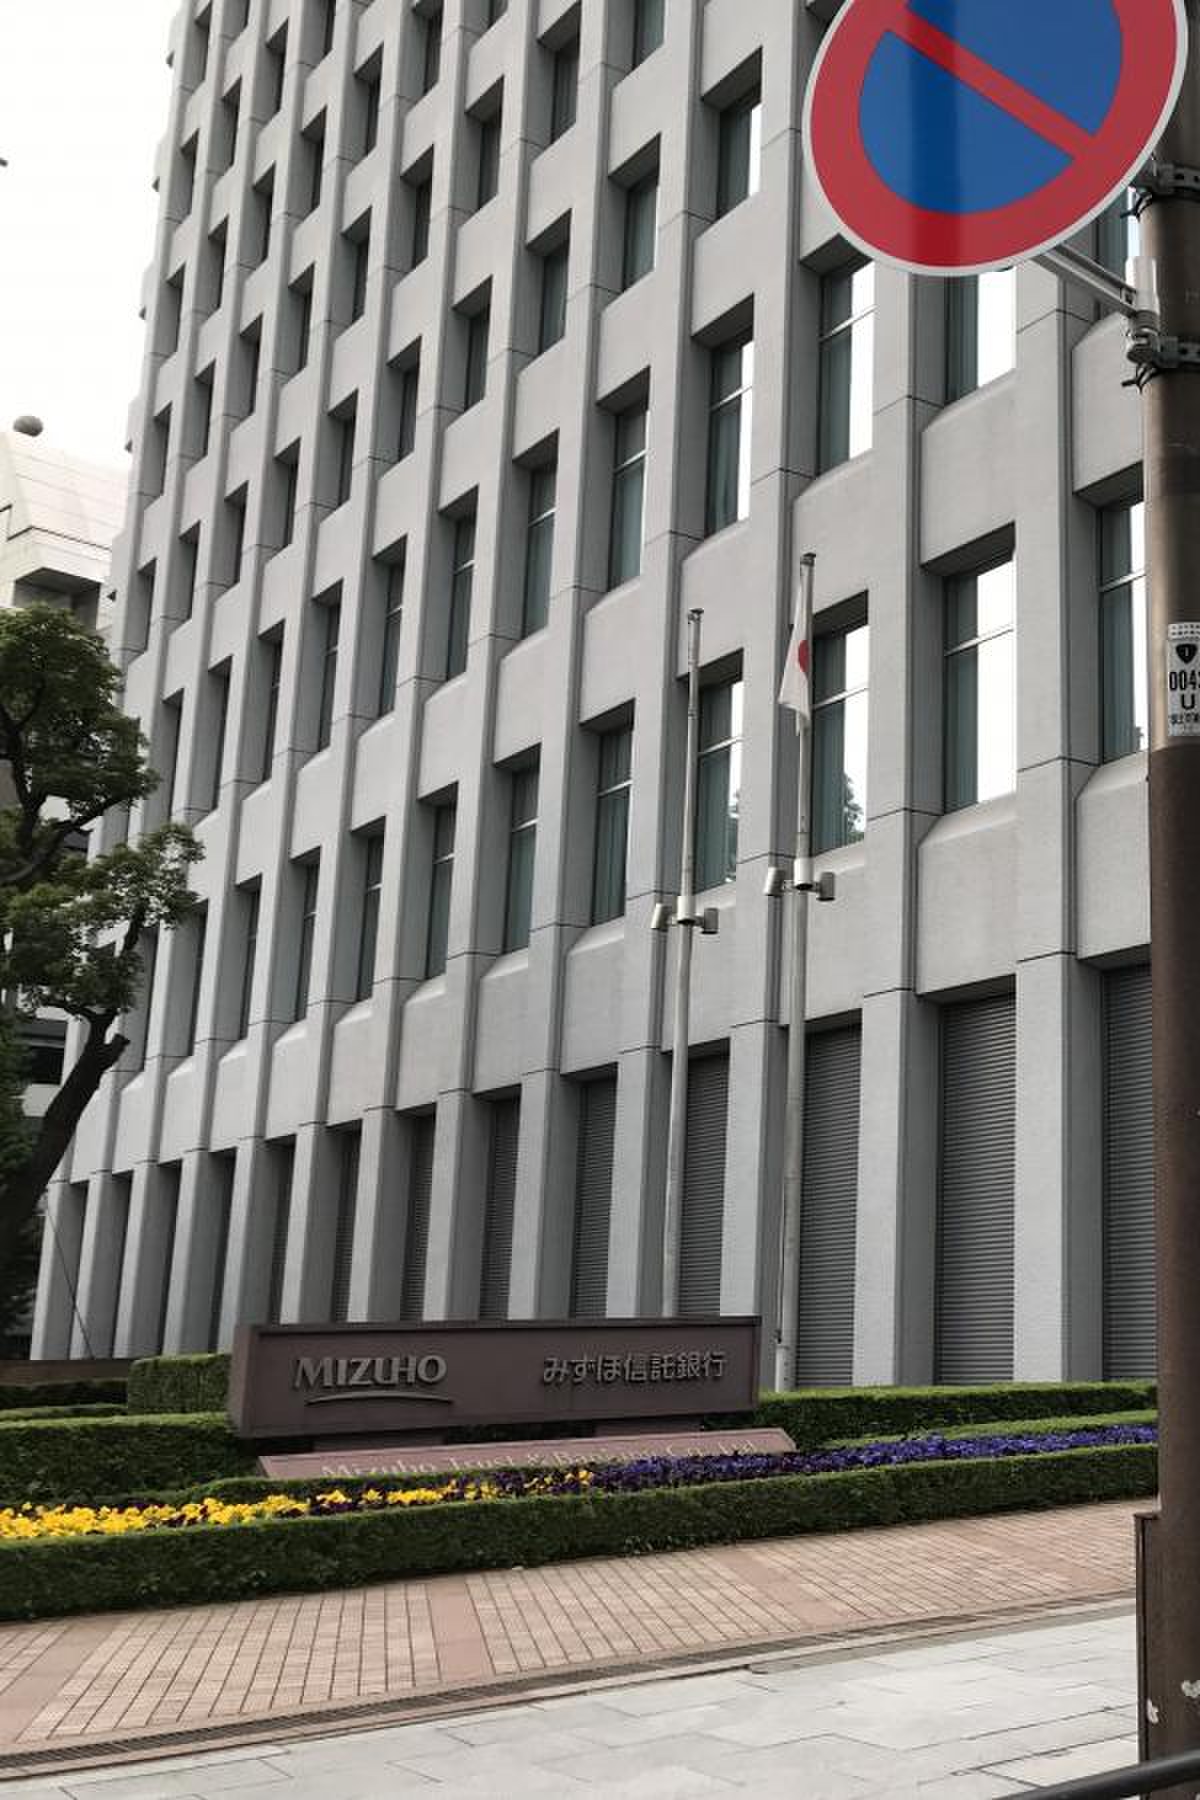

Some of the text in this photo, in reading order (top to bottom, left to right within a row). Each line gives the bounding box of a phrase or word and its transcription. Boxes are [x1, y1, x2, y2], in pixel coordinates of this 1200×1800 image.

[292, 1354, 448, 1388] MIZUHO
[543, 1351, 728, 1383] みずほ信託銀行
